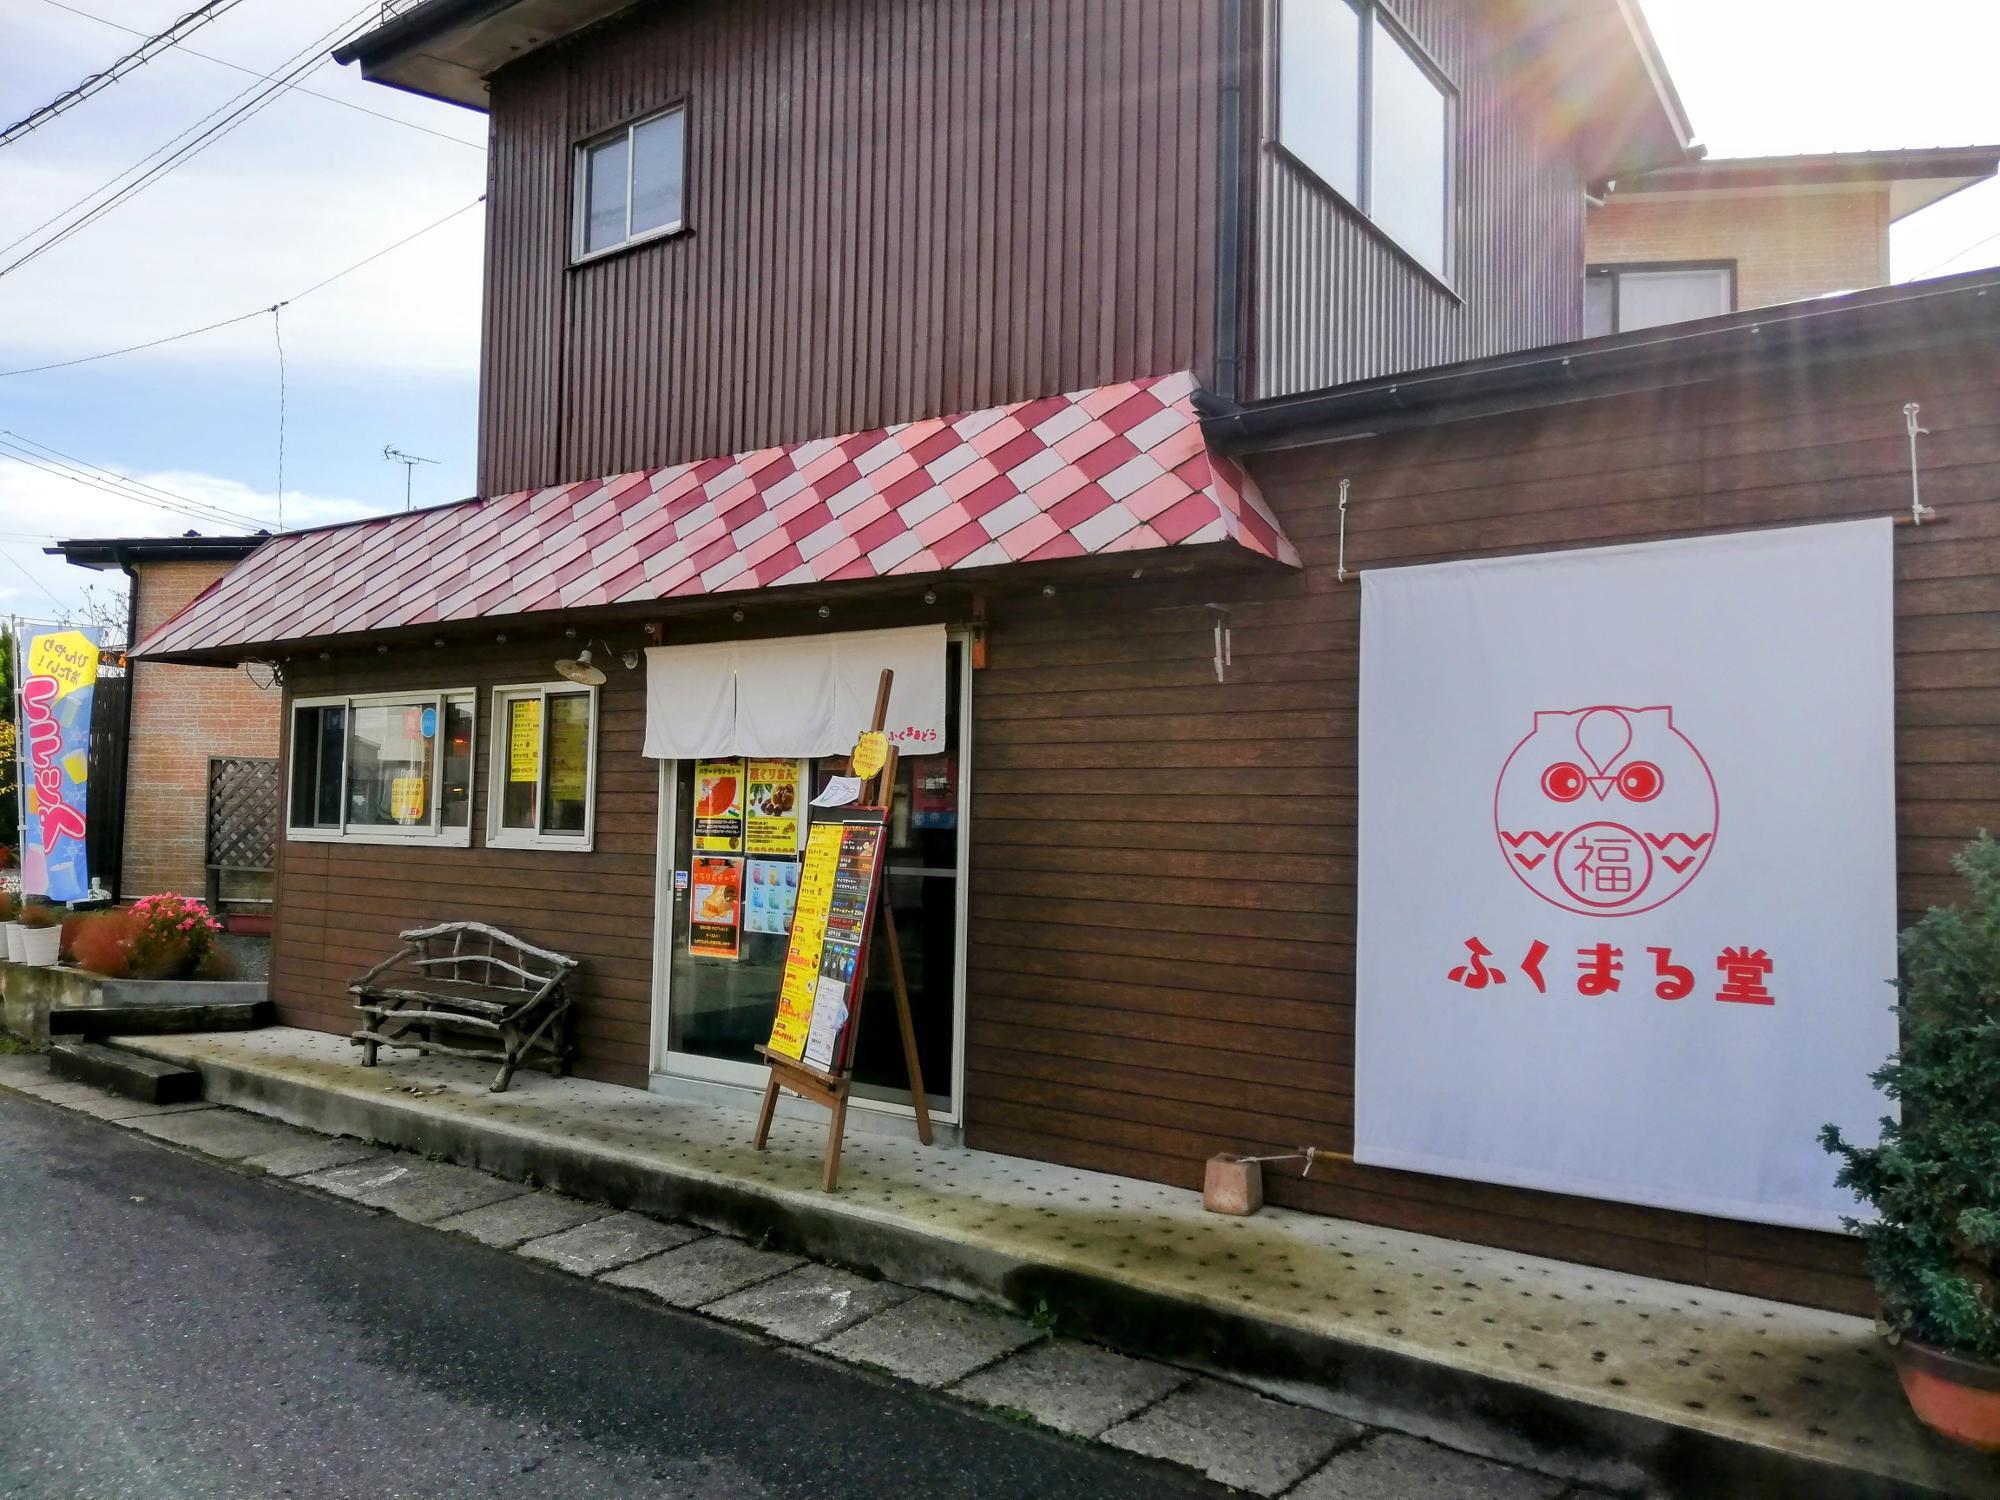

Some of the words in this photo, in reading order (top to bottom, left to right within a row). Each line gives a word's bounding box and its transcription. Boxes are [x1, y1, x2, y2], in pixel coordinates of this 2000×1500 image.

[888, 726, 937, 741] ふくまるどう
[1573, 836, 1633, 892] 福
[1447, 936, 1776, 1006] ふくまる堂
